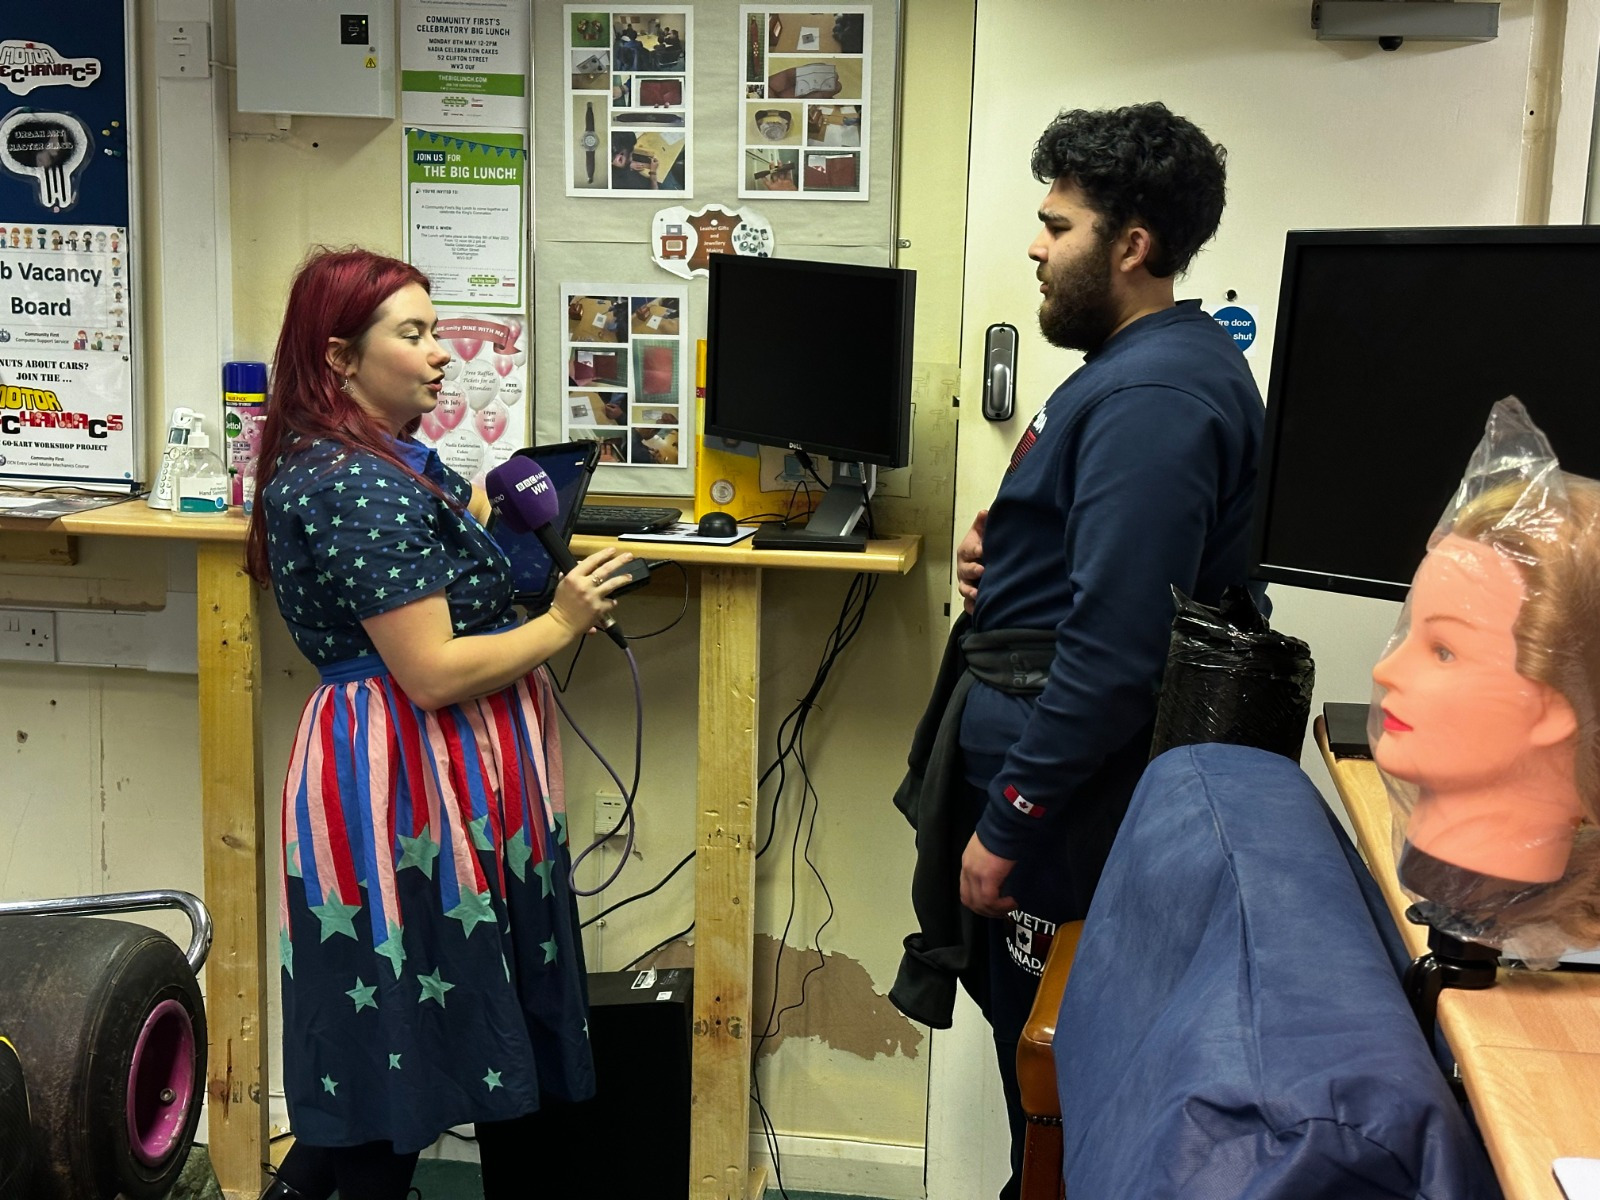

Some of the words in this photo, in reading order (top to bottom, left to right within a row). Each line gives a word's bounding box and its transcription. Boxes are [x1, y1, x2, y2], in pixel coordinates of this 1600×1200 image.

[426, 16, 471, 24] COMMUNITY
[473, 18, 501, 26] FIRST'S
[417, 25, 468, 34] CELEBRATORY
[0, 46, 55, 65] MOTOR
[0, 63, 97, 82] ECHANIACS
[424, 166, 446, 177] THE
[450, 166, 469, 178] BIG
[474, 167, 516, 179] LUNCH!
[18, 262, 102, 287] Vacancy
[11, 297, 71, 316] Board
[1233, 332, 1252, 340] shut
[25, 360, 57, 369] ABOUT
[60, 362, 89, 370] CARS?
[16, 372, 38, 380] JOIN
[40, 373, 60, 382] THE
[0, 411, 123, 438] CHANIACS
[515, 475, 538, 492] BBC
[531, 481, 548, 495] WM
